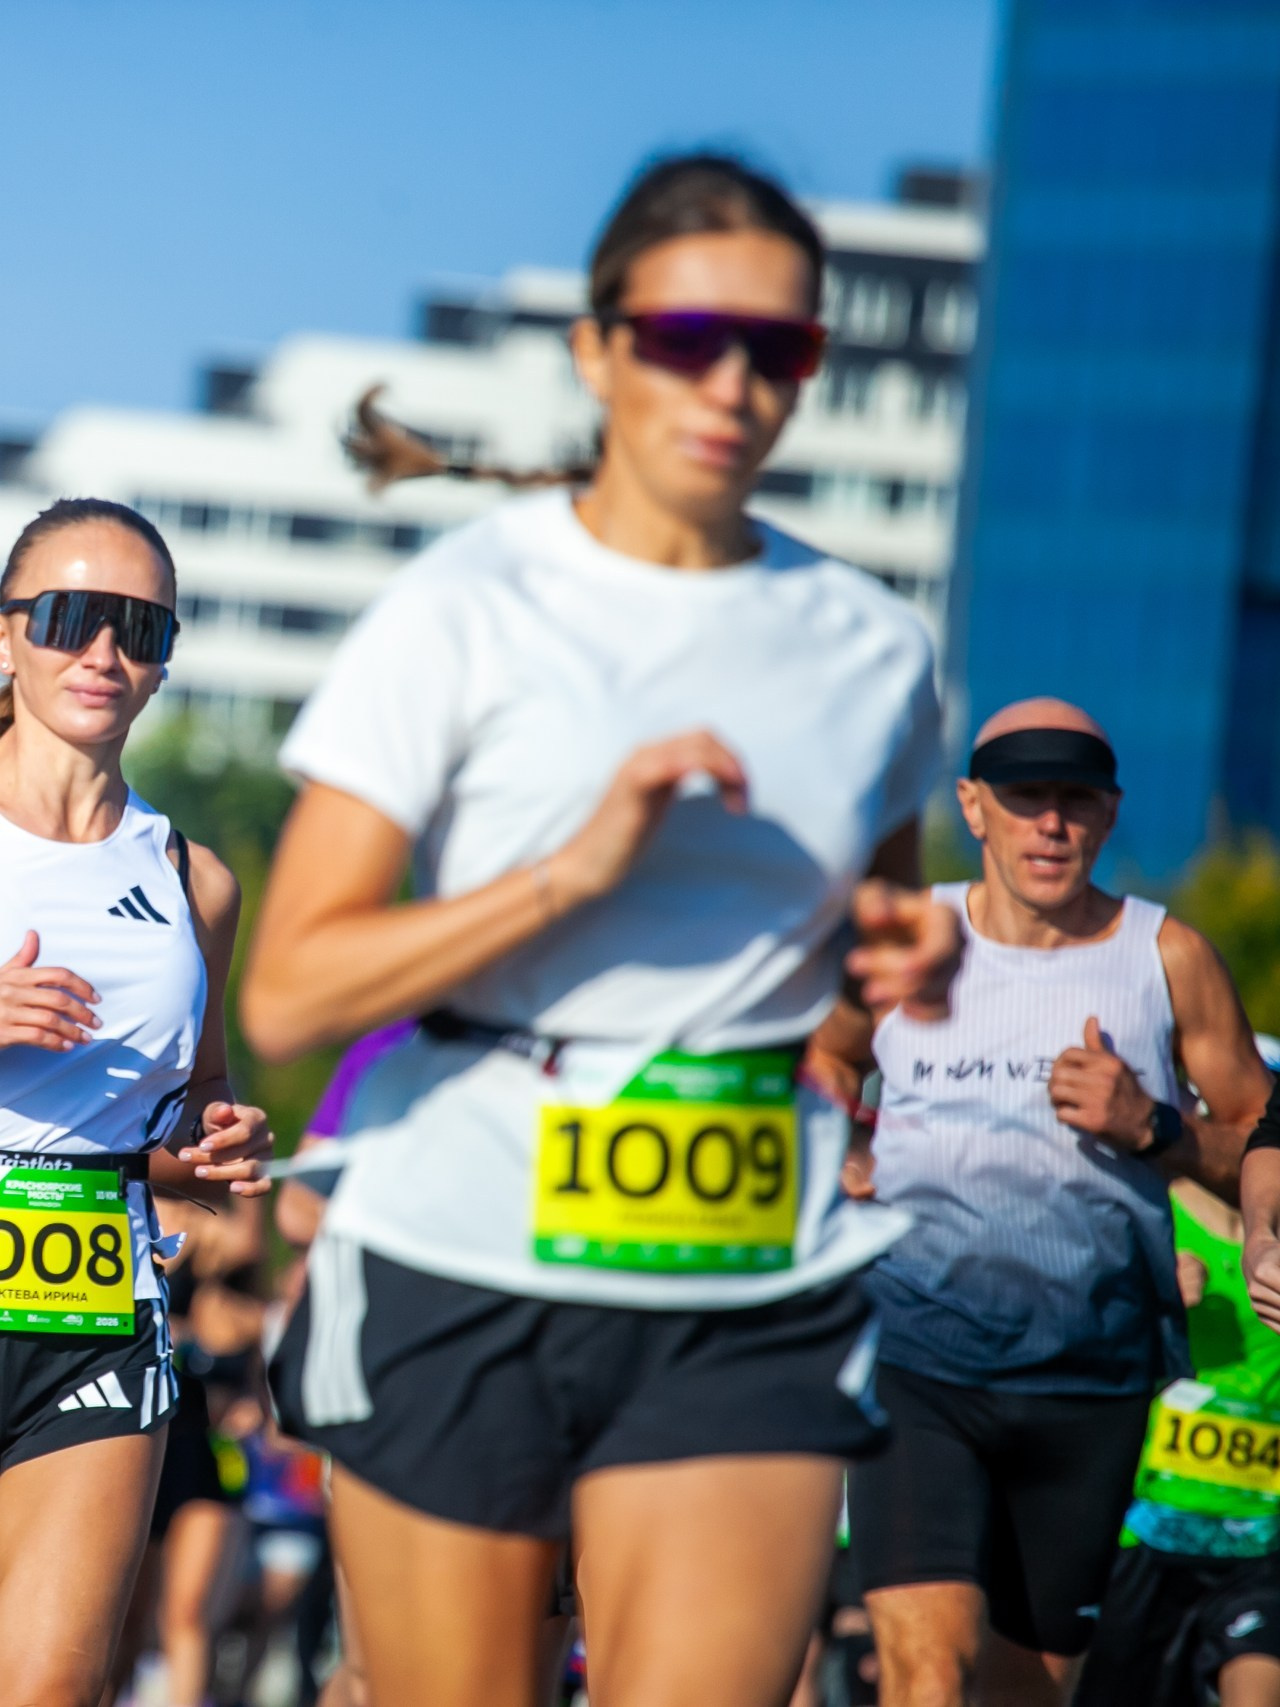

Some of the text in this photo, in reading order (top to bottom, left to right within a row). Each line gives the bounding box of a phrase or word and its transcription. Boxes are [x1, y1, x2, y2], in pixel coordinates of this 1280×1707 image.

[553, 1119, 786, 1207] 1009
[44, 1291, 89, 1302] ИРИНА
[1163, 1415, 1280, 1471] 1084
